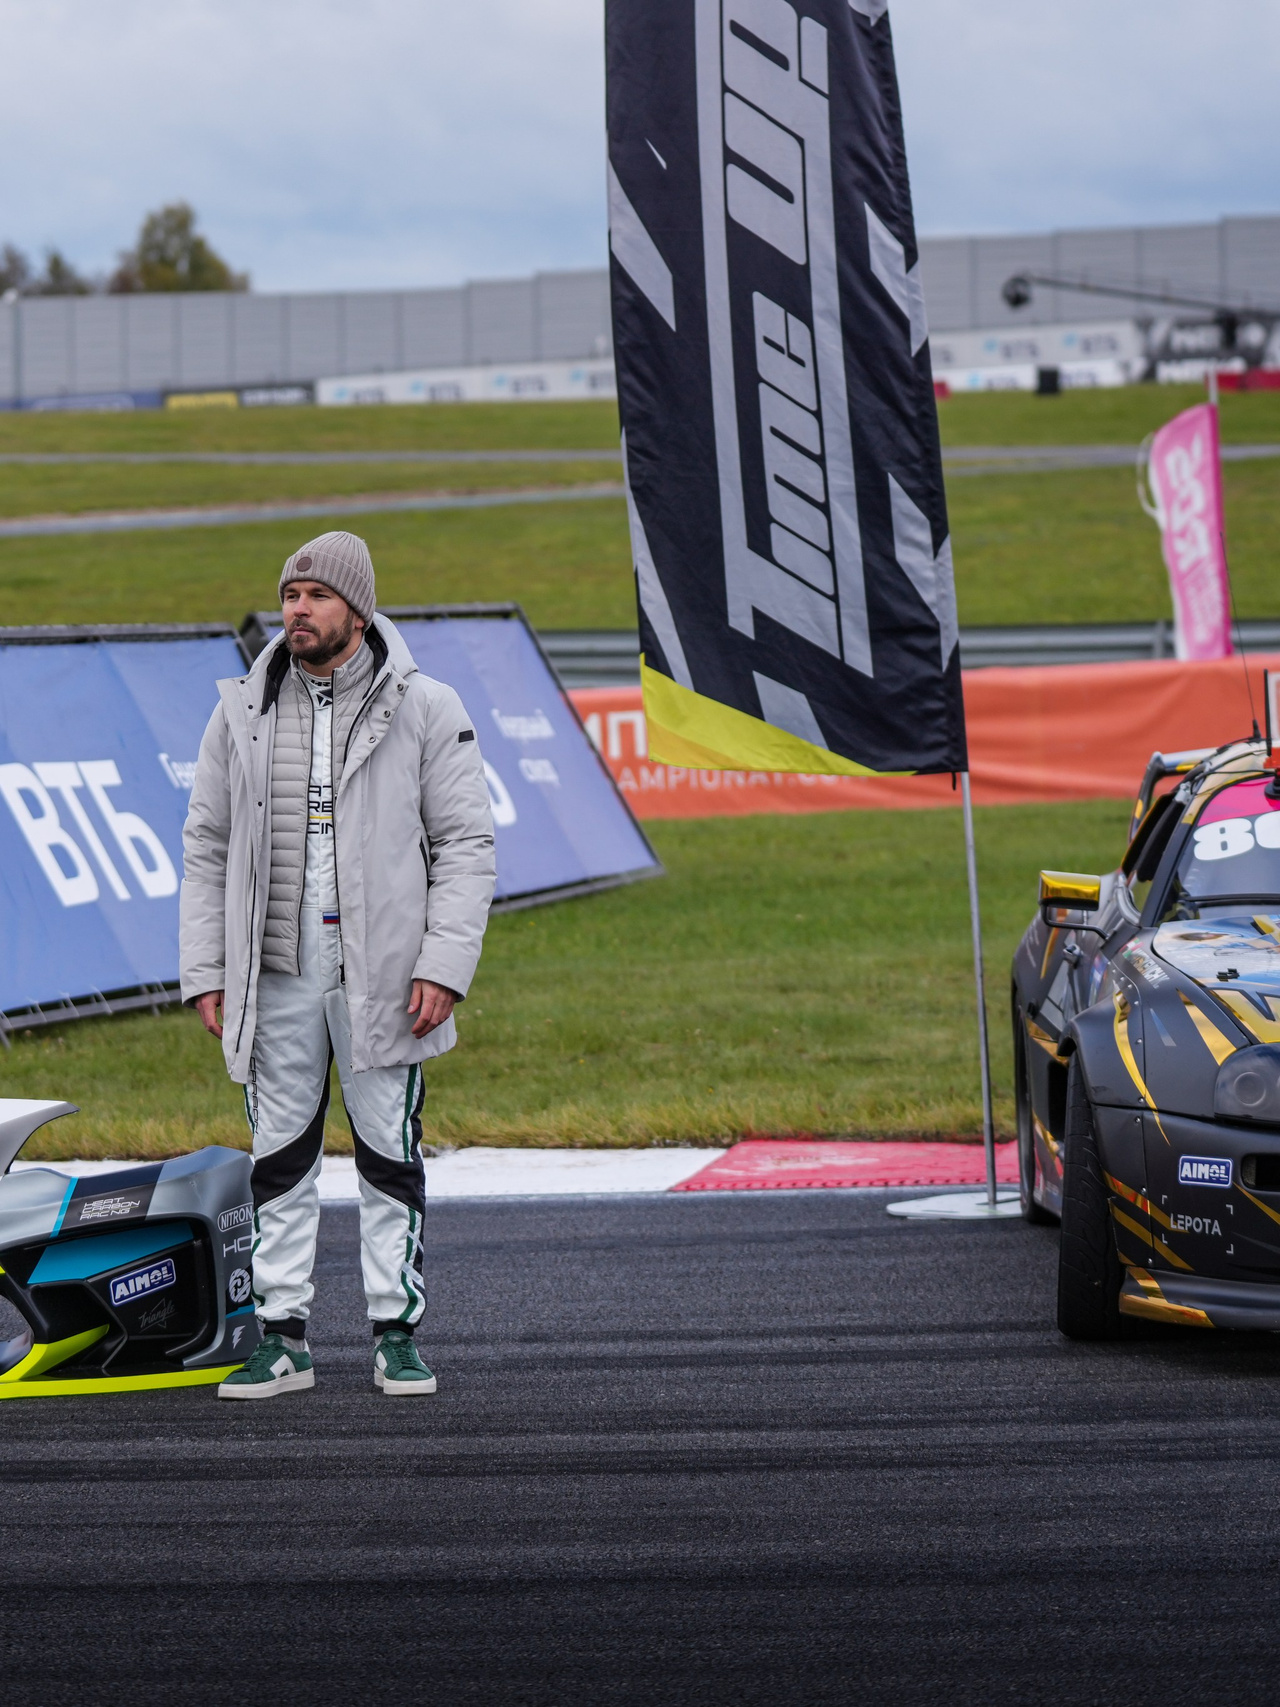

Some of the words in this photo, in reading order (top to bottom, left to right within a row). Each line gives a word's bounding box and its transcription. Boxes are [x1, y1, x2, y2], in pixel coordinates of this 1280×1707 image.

[1180, 1161, 1229, 1182] AIMOL
[82, 1200, 141, 1214] CARBON
[83, 1196, 125, 1208] HEAT
[221, 1205, 253, 1230] NITRON
[1170, 1213, 1222, 1237] LEPOTA
[114, 1265, 174, 1301] AIMOL
